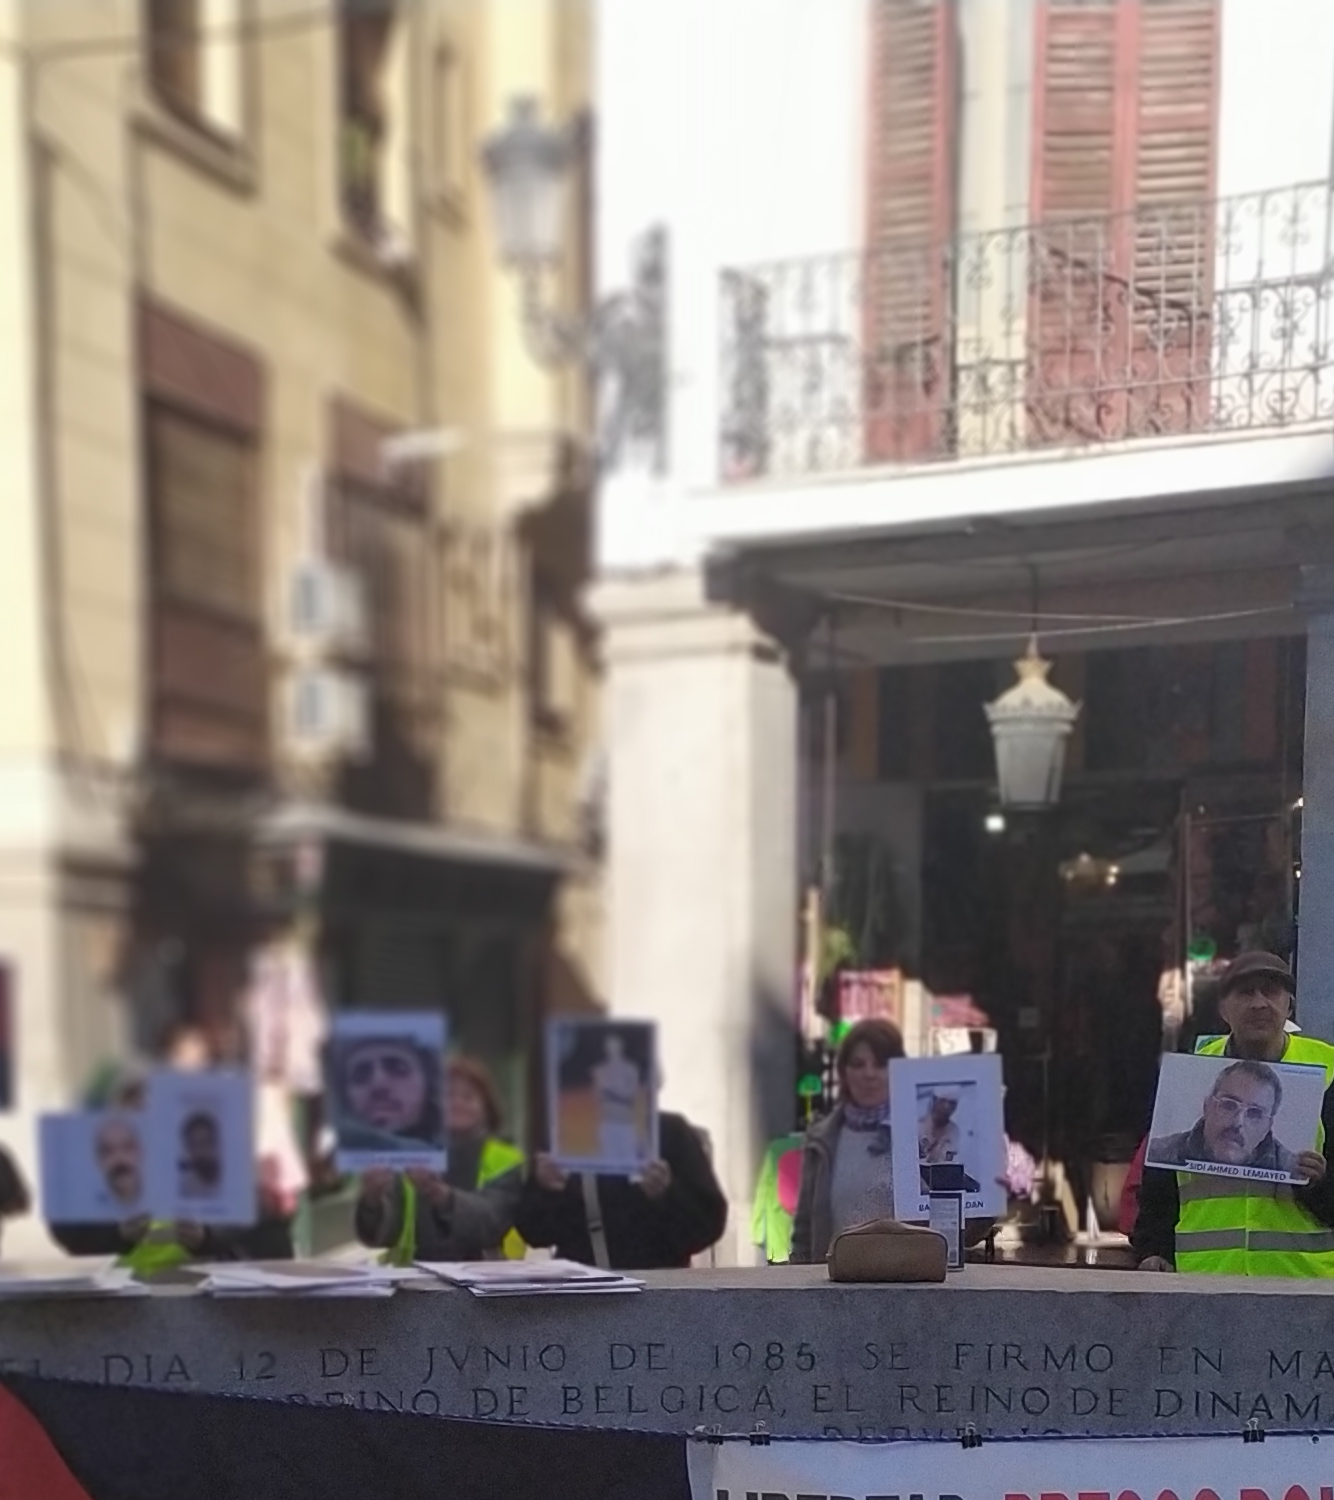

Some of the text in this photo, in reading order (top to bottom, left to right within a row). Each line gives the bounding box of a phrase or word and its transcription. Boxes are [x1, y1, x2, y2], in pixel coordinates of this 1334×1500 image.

[1189, 1162, 1207, 1171] SIDI
[1207, 1165, 1239, 1175] AHMED
[103, 1354, 193, 1384] DIA
[238, 1351, 276, 1379] 12
[319, 1348, 382, 1379] DE
[421, 1343, 567, 1383] JVNIO
[609, 1343, 669, 1372] DE
[714, 1342, 816, 1372] 1985
[861, 1343, 910, 1372] SE
[953, 1343, 1113, 1374] FIRMO
[1159, 1346, 1223, 1376] EN
[473, 1386, 529, 1416] DE
[813, 1385, 866, 1414] EL
[897, 1385, 1051, 1416] REINO
[1070, 1388, 1128, 1417] DE
